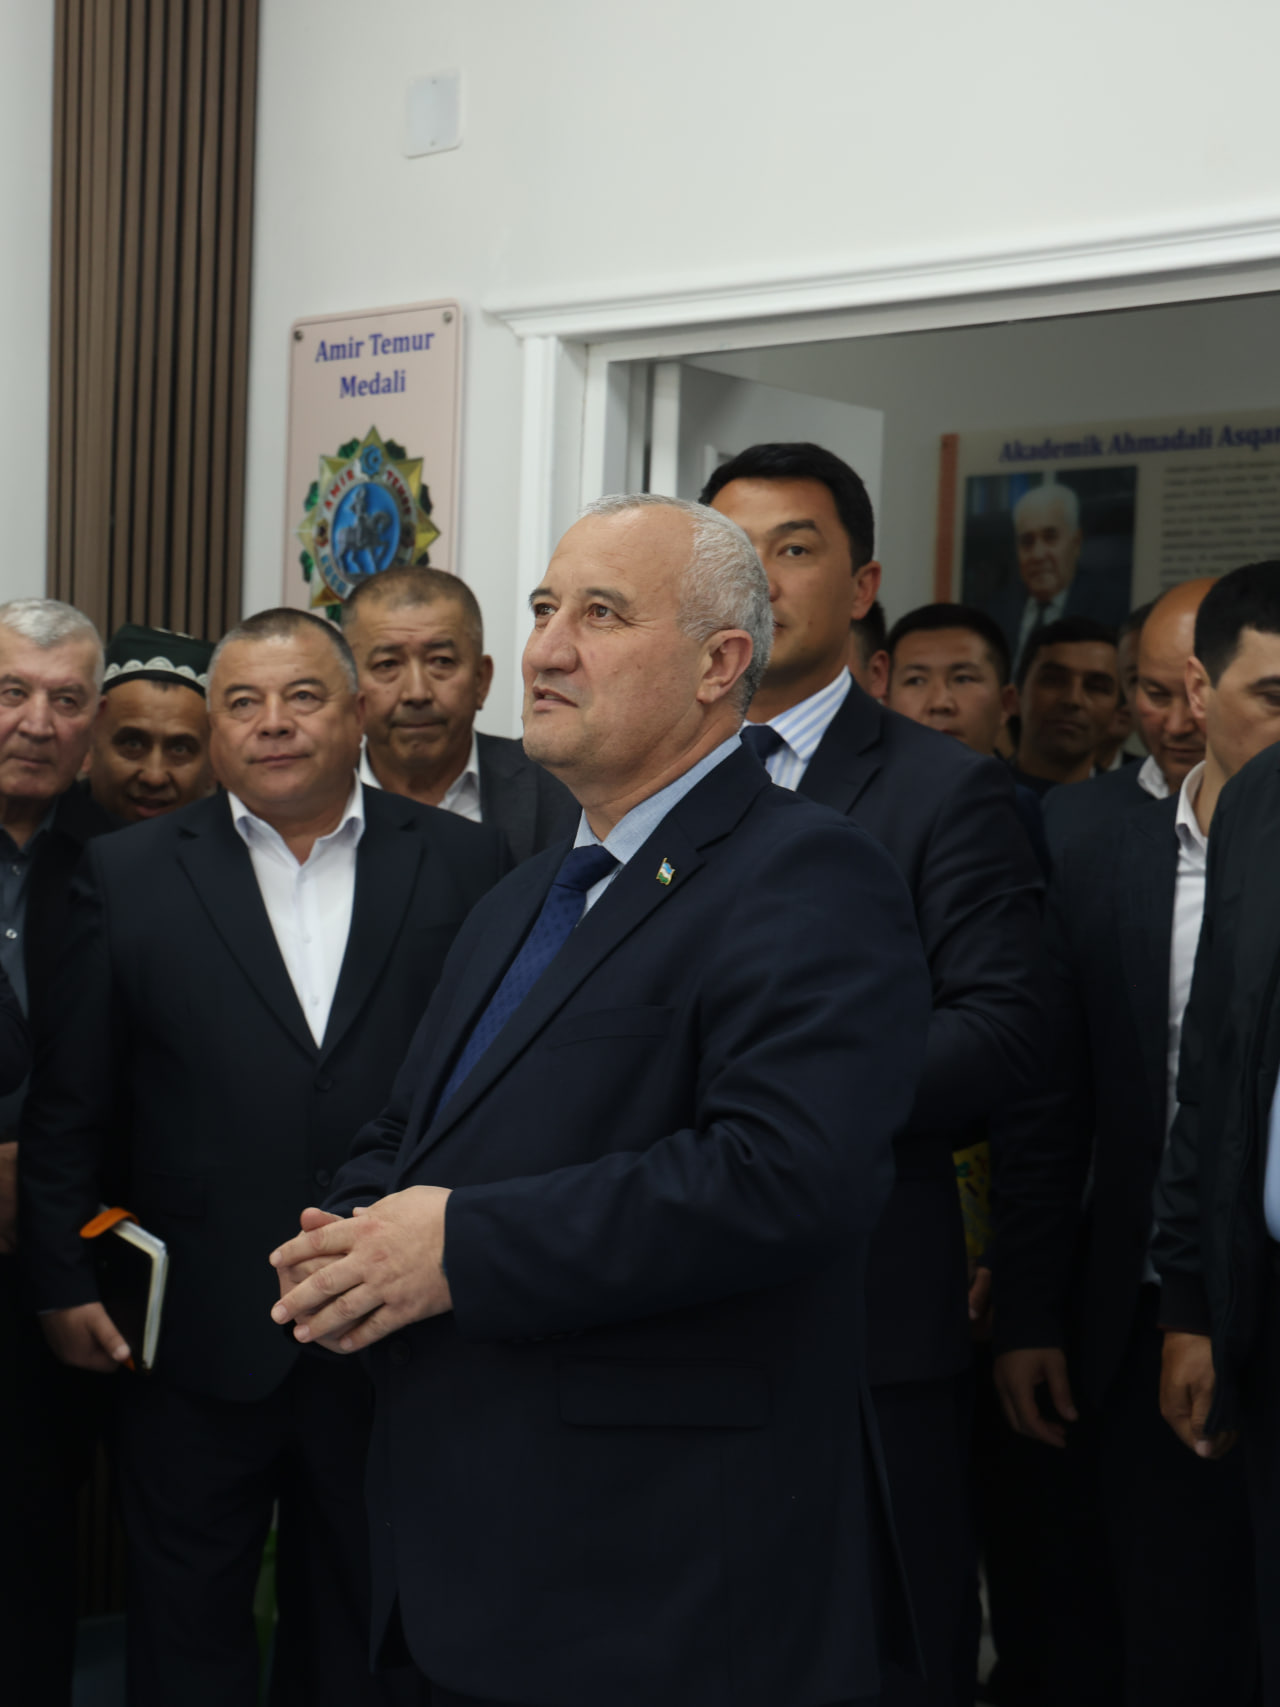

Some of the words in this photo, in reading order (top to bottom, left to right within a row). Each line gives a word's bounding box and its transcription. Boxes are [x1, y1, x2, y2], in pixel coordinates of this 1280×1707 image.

[315, 336, 365, 363] Amir
[370, 331, 435, 356] Temur
[339, 370, 406, 398] Medali
[1108, 427, 1213, 454] Ahmadali
